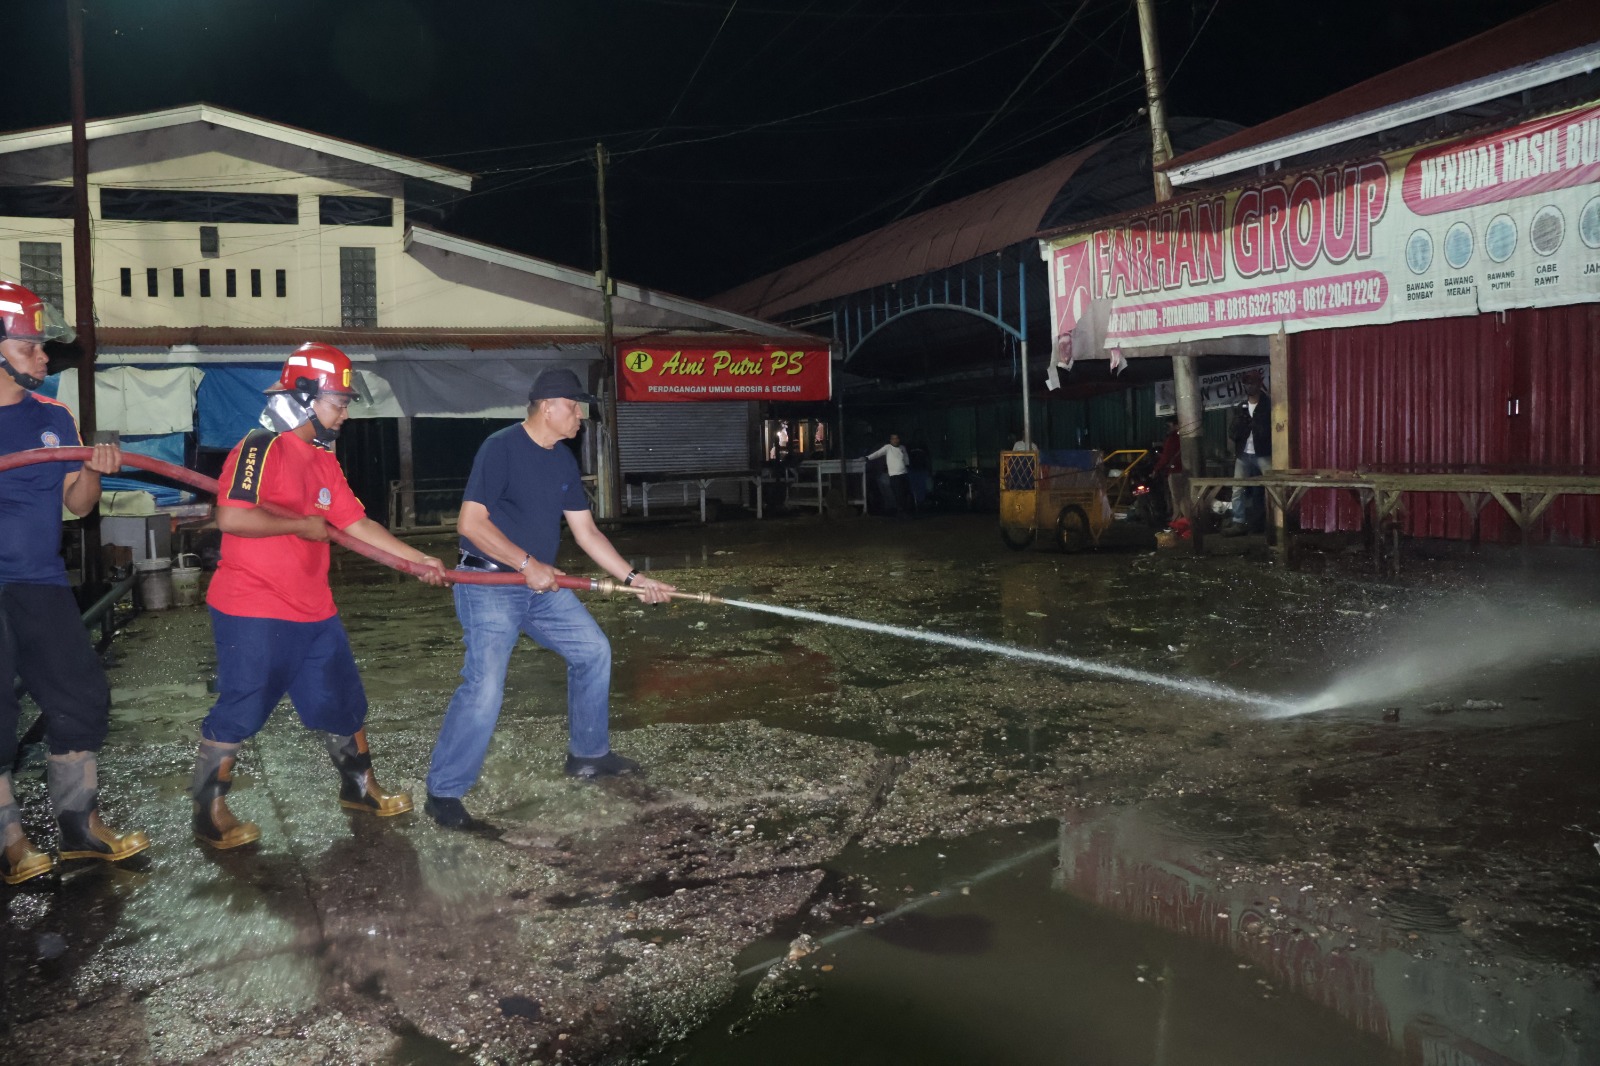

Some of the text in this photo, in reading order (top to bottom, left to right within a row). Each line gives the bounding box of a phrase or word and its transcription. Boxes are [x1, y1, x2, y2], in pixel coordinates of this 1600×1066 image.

[1420, 117, 1600, 199] MENJUAL HASIL BU
[1093, 158, 1389, 299] FARHAN GROUP
[1536, 264, 1557, 274] CABE
[1444, 275, 1474, 286] BAWANG
[1487, 271, 1515, 280] BAWANG
[1406, 281, 1434, 291] BAWANG
[1491, 282, 1511, 290] PUTIH
[1534, 276, 1559, 286] RAWIT
[1407, 291, 1433, 301] BOMBAY
[1447, 287, 1471, 296] MERAH
[1227, 296, 1247, 320] 0813
[1249, 293, 1271, 318] 6322
[1272, 289, 1296, 315] 5628
[1303, 285, 1326, 311] 0812
[1328, 281, 1352, 307] 2047
[1354, 277, 1381, 305] 2242
[659, 351, 805, 377] Aini Putri PS
[241, 447, 258, 491] PEMADAM
